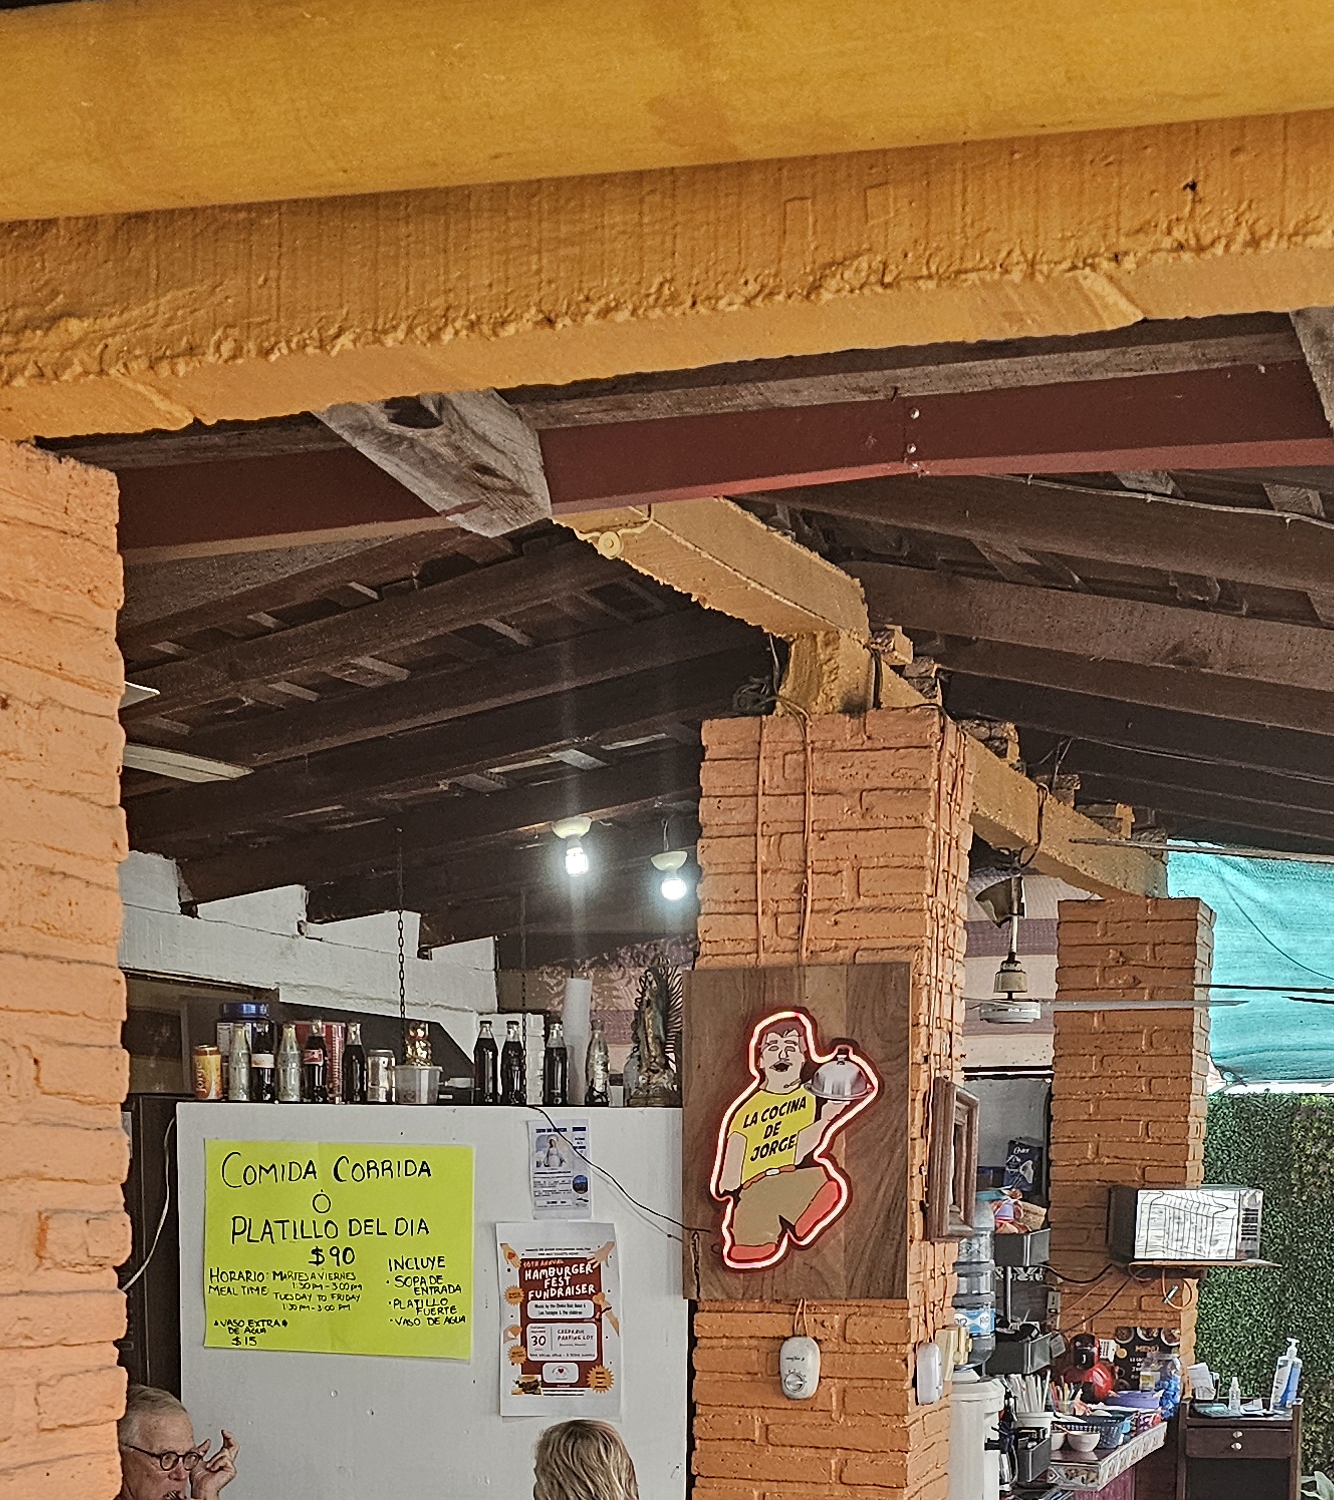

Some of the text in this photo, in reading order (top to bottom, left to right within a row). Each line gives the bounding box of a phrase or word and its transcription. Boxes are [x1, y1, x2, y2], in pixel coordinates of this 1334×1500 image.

[743, 1096, 806, 1128] LA COCINA
[763, 1121, 782, 1139] DE
[750, 1134, 797, 1161] JORGE
[221, 1151, 432, 1188] COMIDA CORRIDA
[231, 1215, 430, 1244] PLATILLO DEL DIA
[308, 1246, 355, 1267] $90
[388, 1255, 445, 1272] INCLUYE
[273, 1271, 309, 1281] MARTES
[318, 1271, 357, 1281] VIERNES
[525, 1263, 593, 1280] HAMBURGER
[395, 1275, 443, 1288] SOPA DE
[544, 1276, 571, 1289] FEST
[209, 1285, 238, 1297] MEAL
[414, 1284, 462, 1296] ENTRADA
[528, 1284, 596, 1300] FUNDRAISER
[273, 1291, 362, 1303] TUESDAY TO FRIDAY
[394, 1298, 449, 1310] PLATILLO
[416, 1305, 457, 1316] FUERTE
[220, 1319, 281, 1328] VASO EXTRA
[395, 1315, 466, 1327] VASO DE AGUA
[228, 1327, 267, 1335] DE AGUA
[231, 1336, 257, 1346] $15
[530, 1335, 547, 1346] 30
